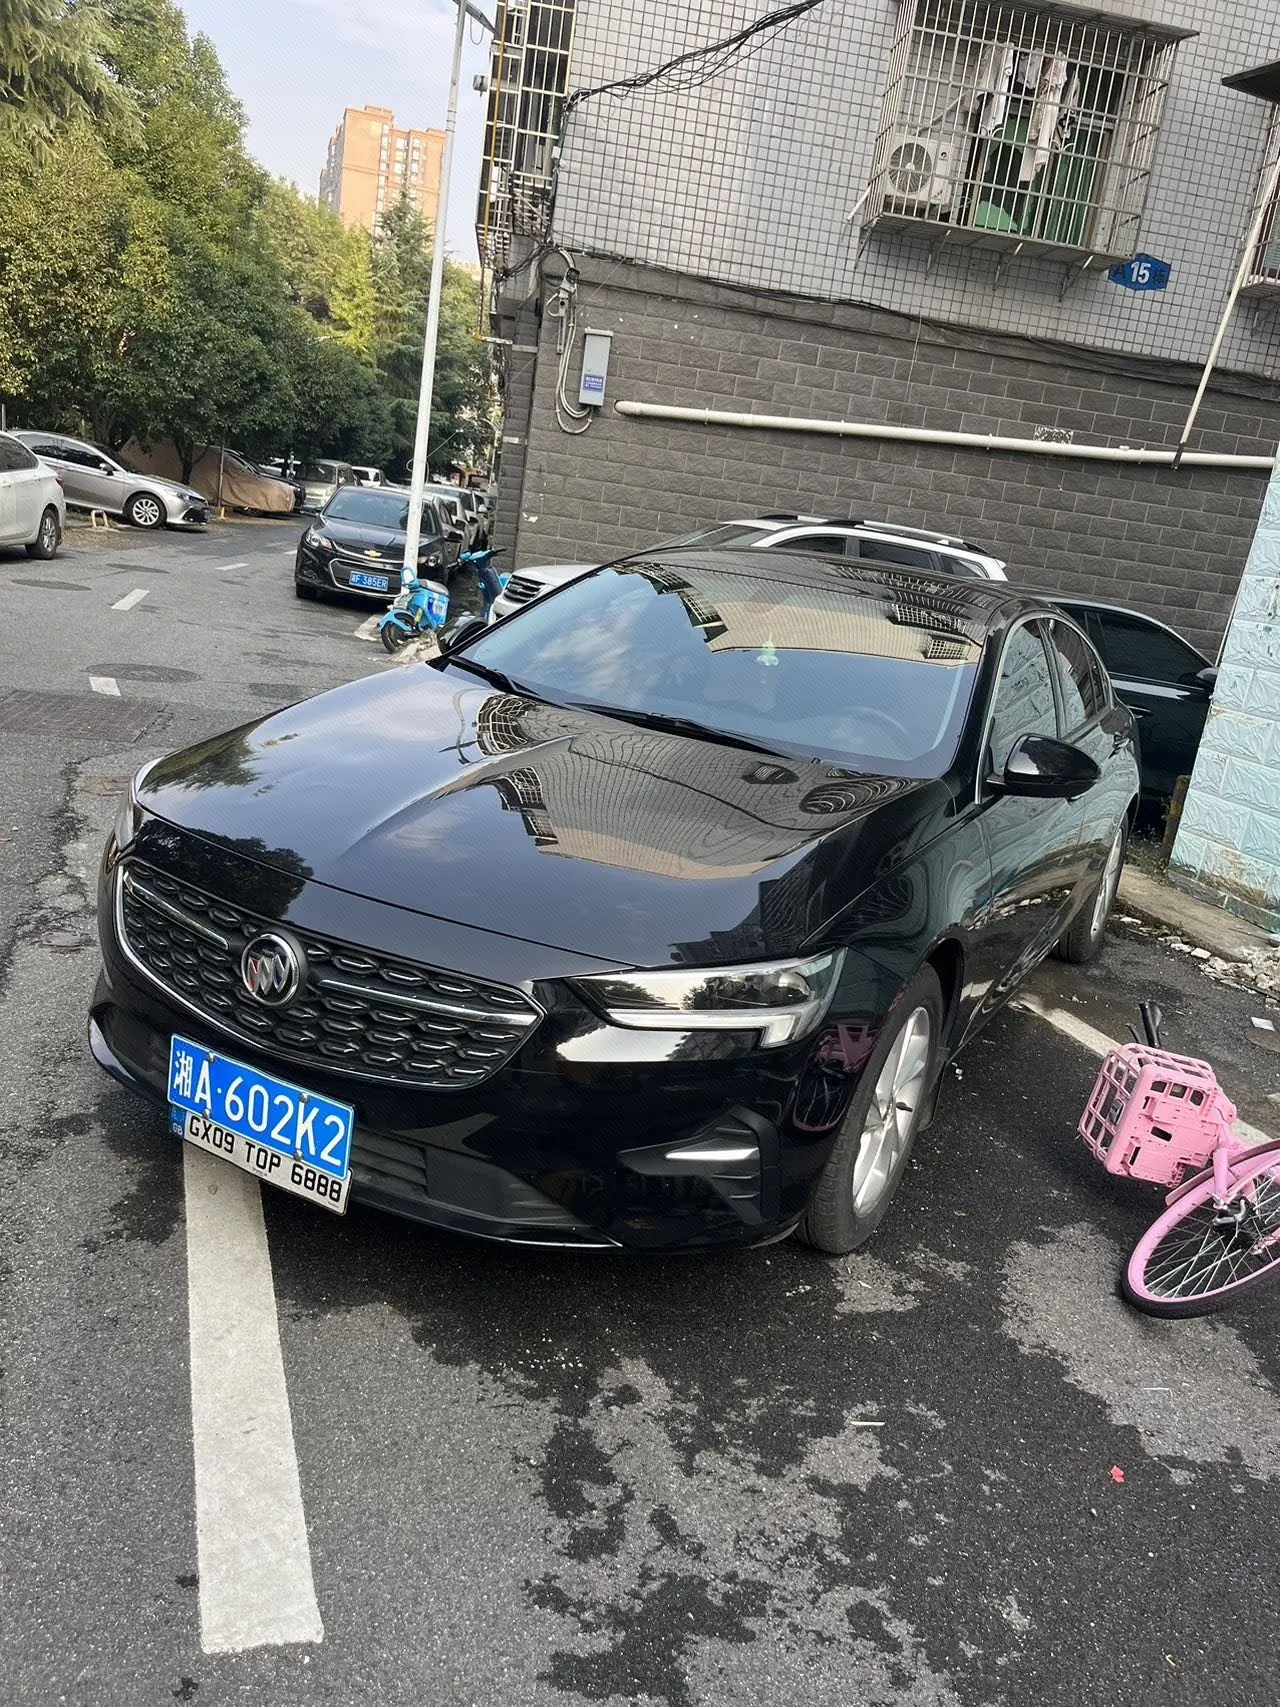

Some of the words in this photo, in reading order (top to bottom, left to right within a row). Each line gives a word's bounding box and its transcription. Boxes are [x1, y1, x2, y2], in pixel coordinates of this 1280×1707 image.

[1131, 261, 1151, 283] 15
[189, 1115, 235, 1154] GX09
[244, 1141, 281, 1173] TOP
[290, 1163, 343, 1203] 6888
